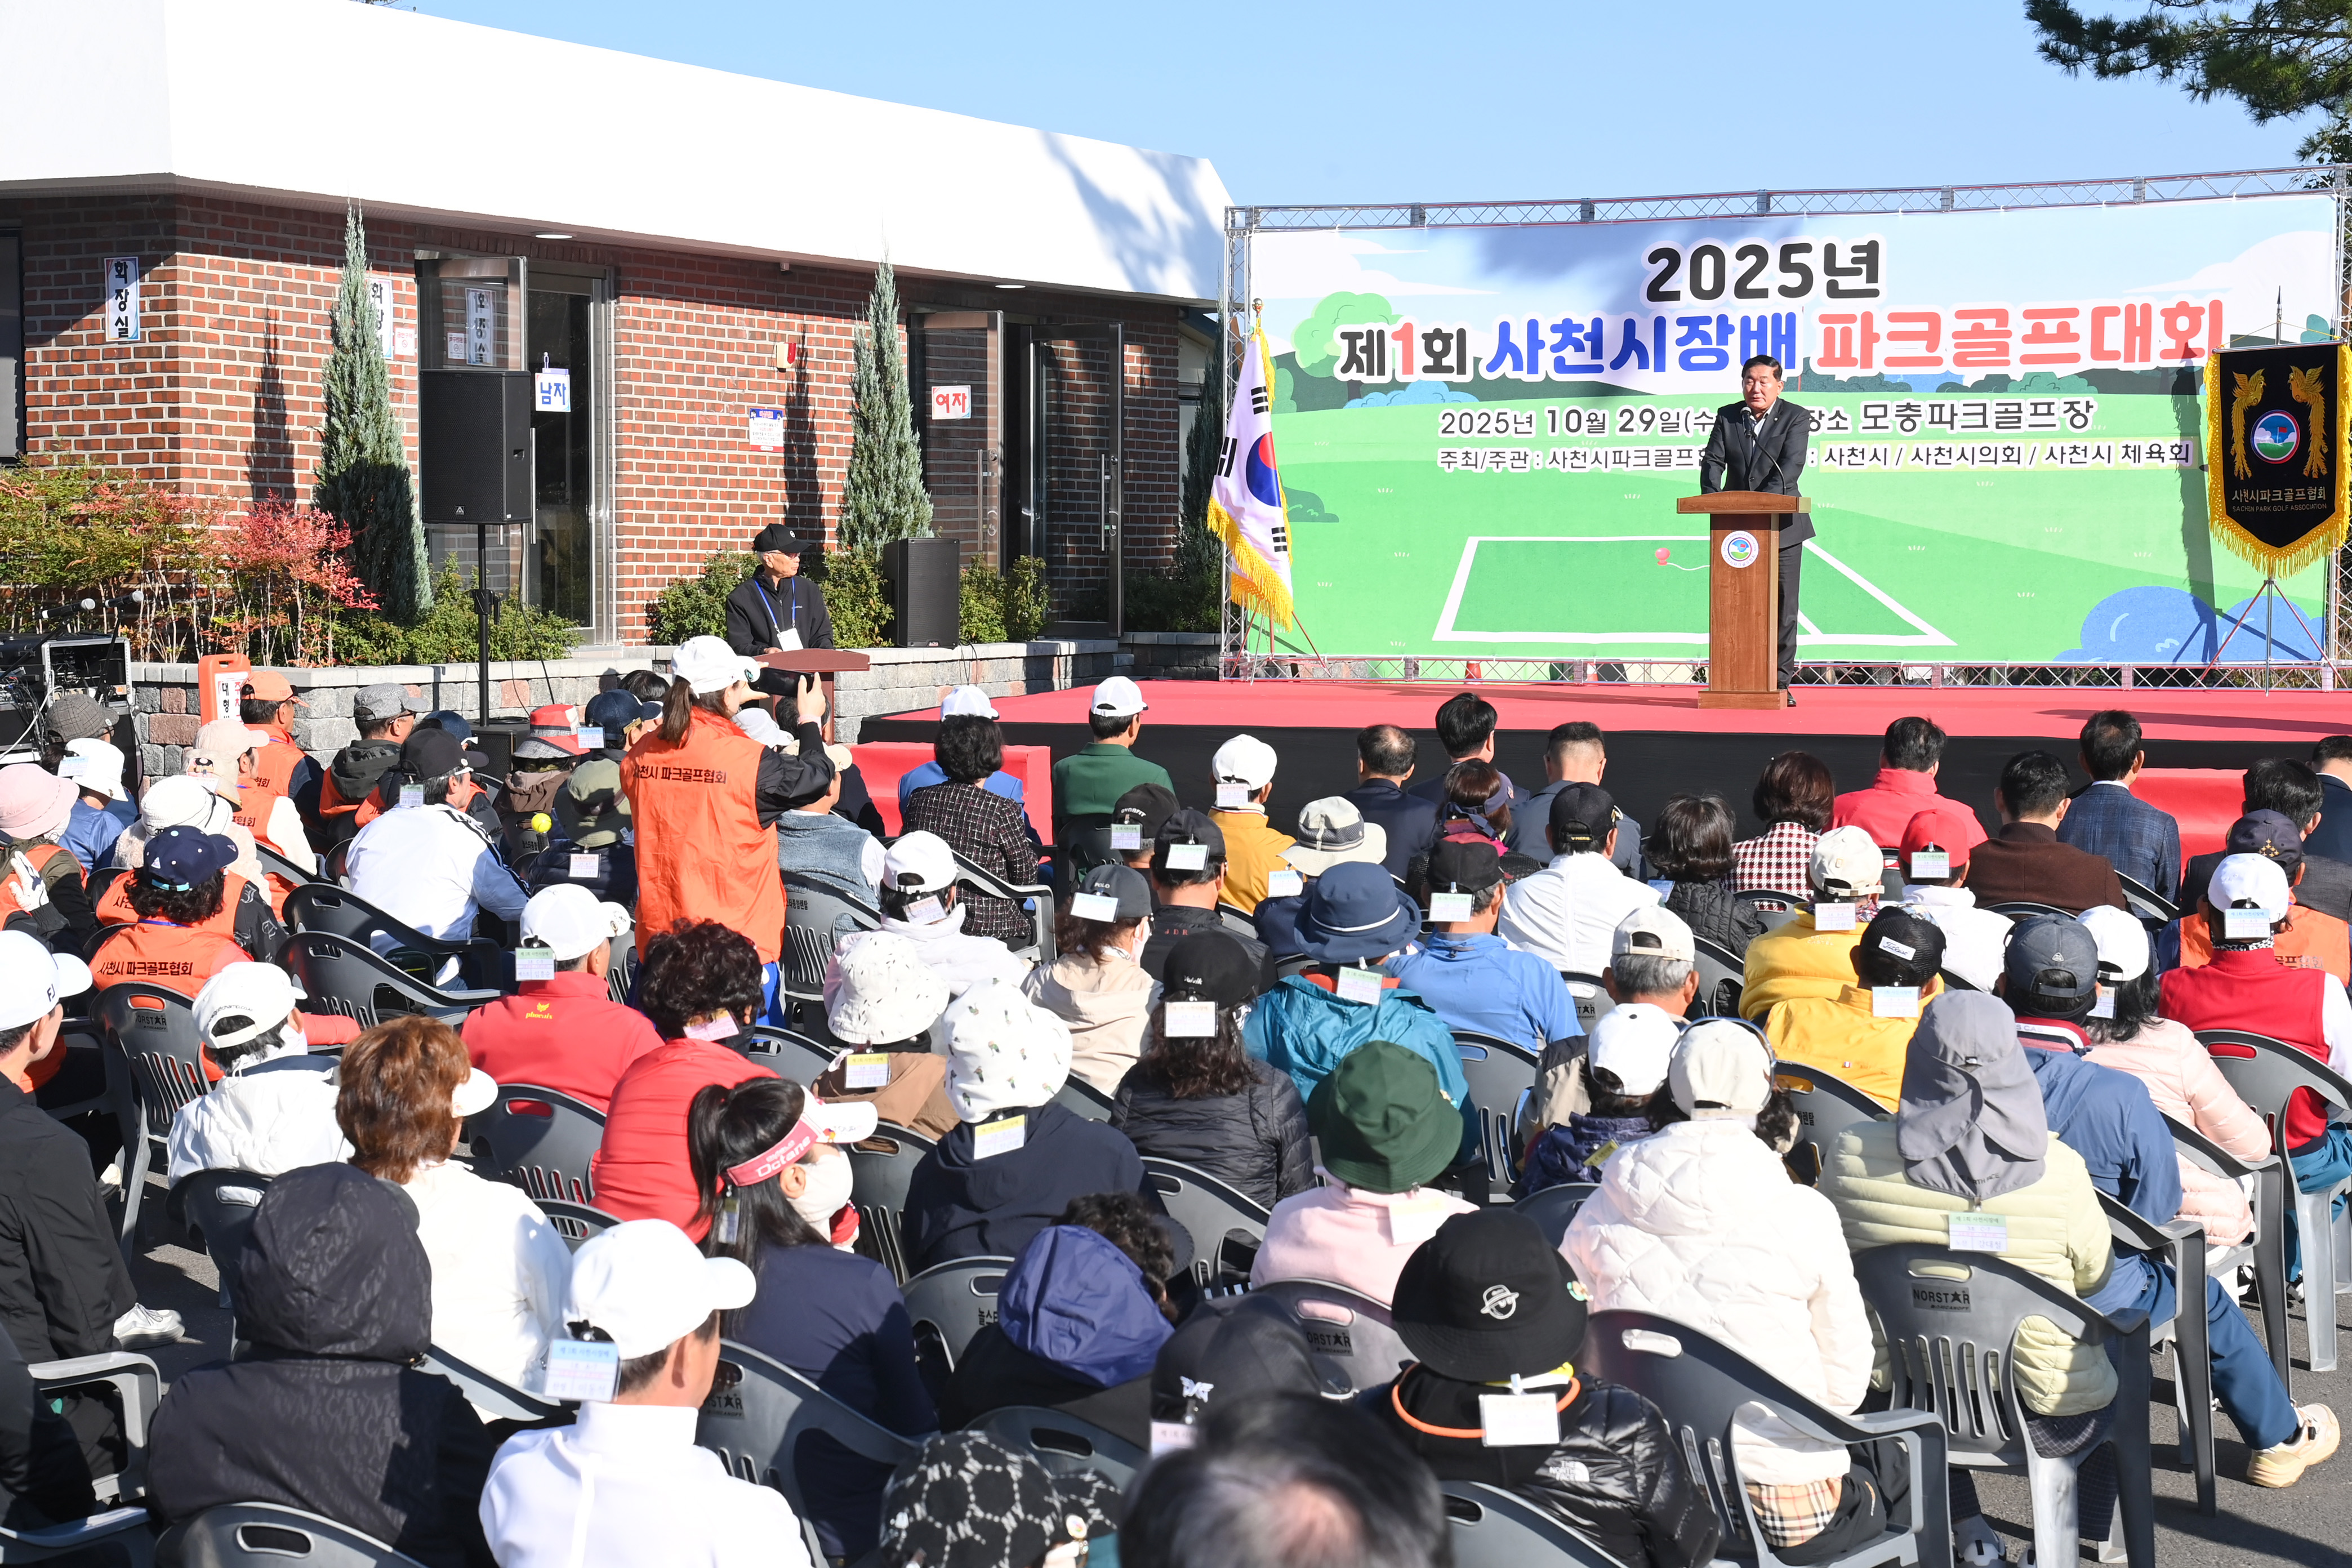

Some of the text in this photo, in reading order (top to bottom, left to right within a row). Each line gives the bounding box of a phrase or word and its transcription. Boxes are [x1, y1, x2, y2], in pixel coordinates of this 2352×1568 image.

[1646, 240, 1880, 302] 2025년
[114, 261, 130, 338] 화장실
[1340, 299, 2223, 376] 제1회 사천시장배 파크골프대회
[540, 382, 565, 405] 남자
[936, 393, 967, 413] 여자
[1441, 410, 1534, 434] 2025년
[1547, 408, 1606, 434] 10월
[1862, 400, 2095, 432] 모충파크골프장
[1440, 450, 1530, 470] 주최/주관
[1824, 447, 1887, 466] 사천시
[1910, 445, 2022, 466] 사천시의회
[2045, 444, 2111, 465] 사천시
[2121, 443, 2189, 464] 체육회
[2231, 486, 2326, 503] 사천시파크골프협회
[661, 767, 727, 784] 파크골프협회
[1121, 808, 1147, 817] DYNAFIT
[1883, 941, 1911, 956] Titleist
[97, 961, 193, 976] 사천시 파크골프협회
[47, 984, 55, 1003] FJ
